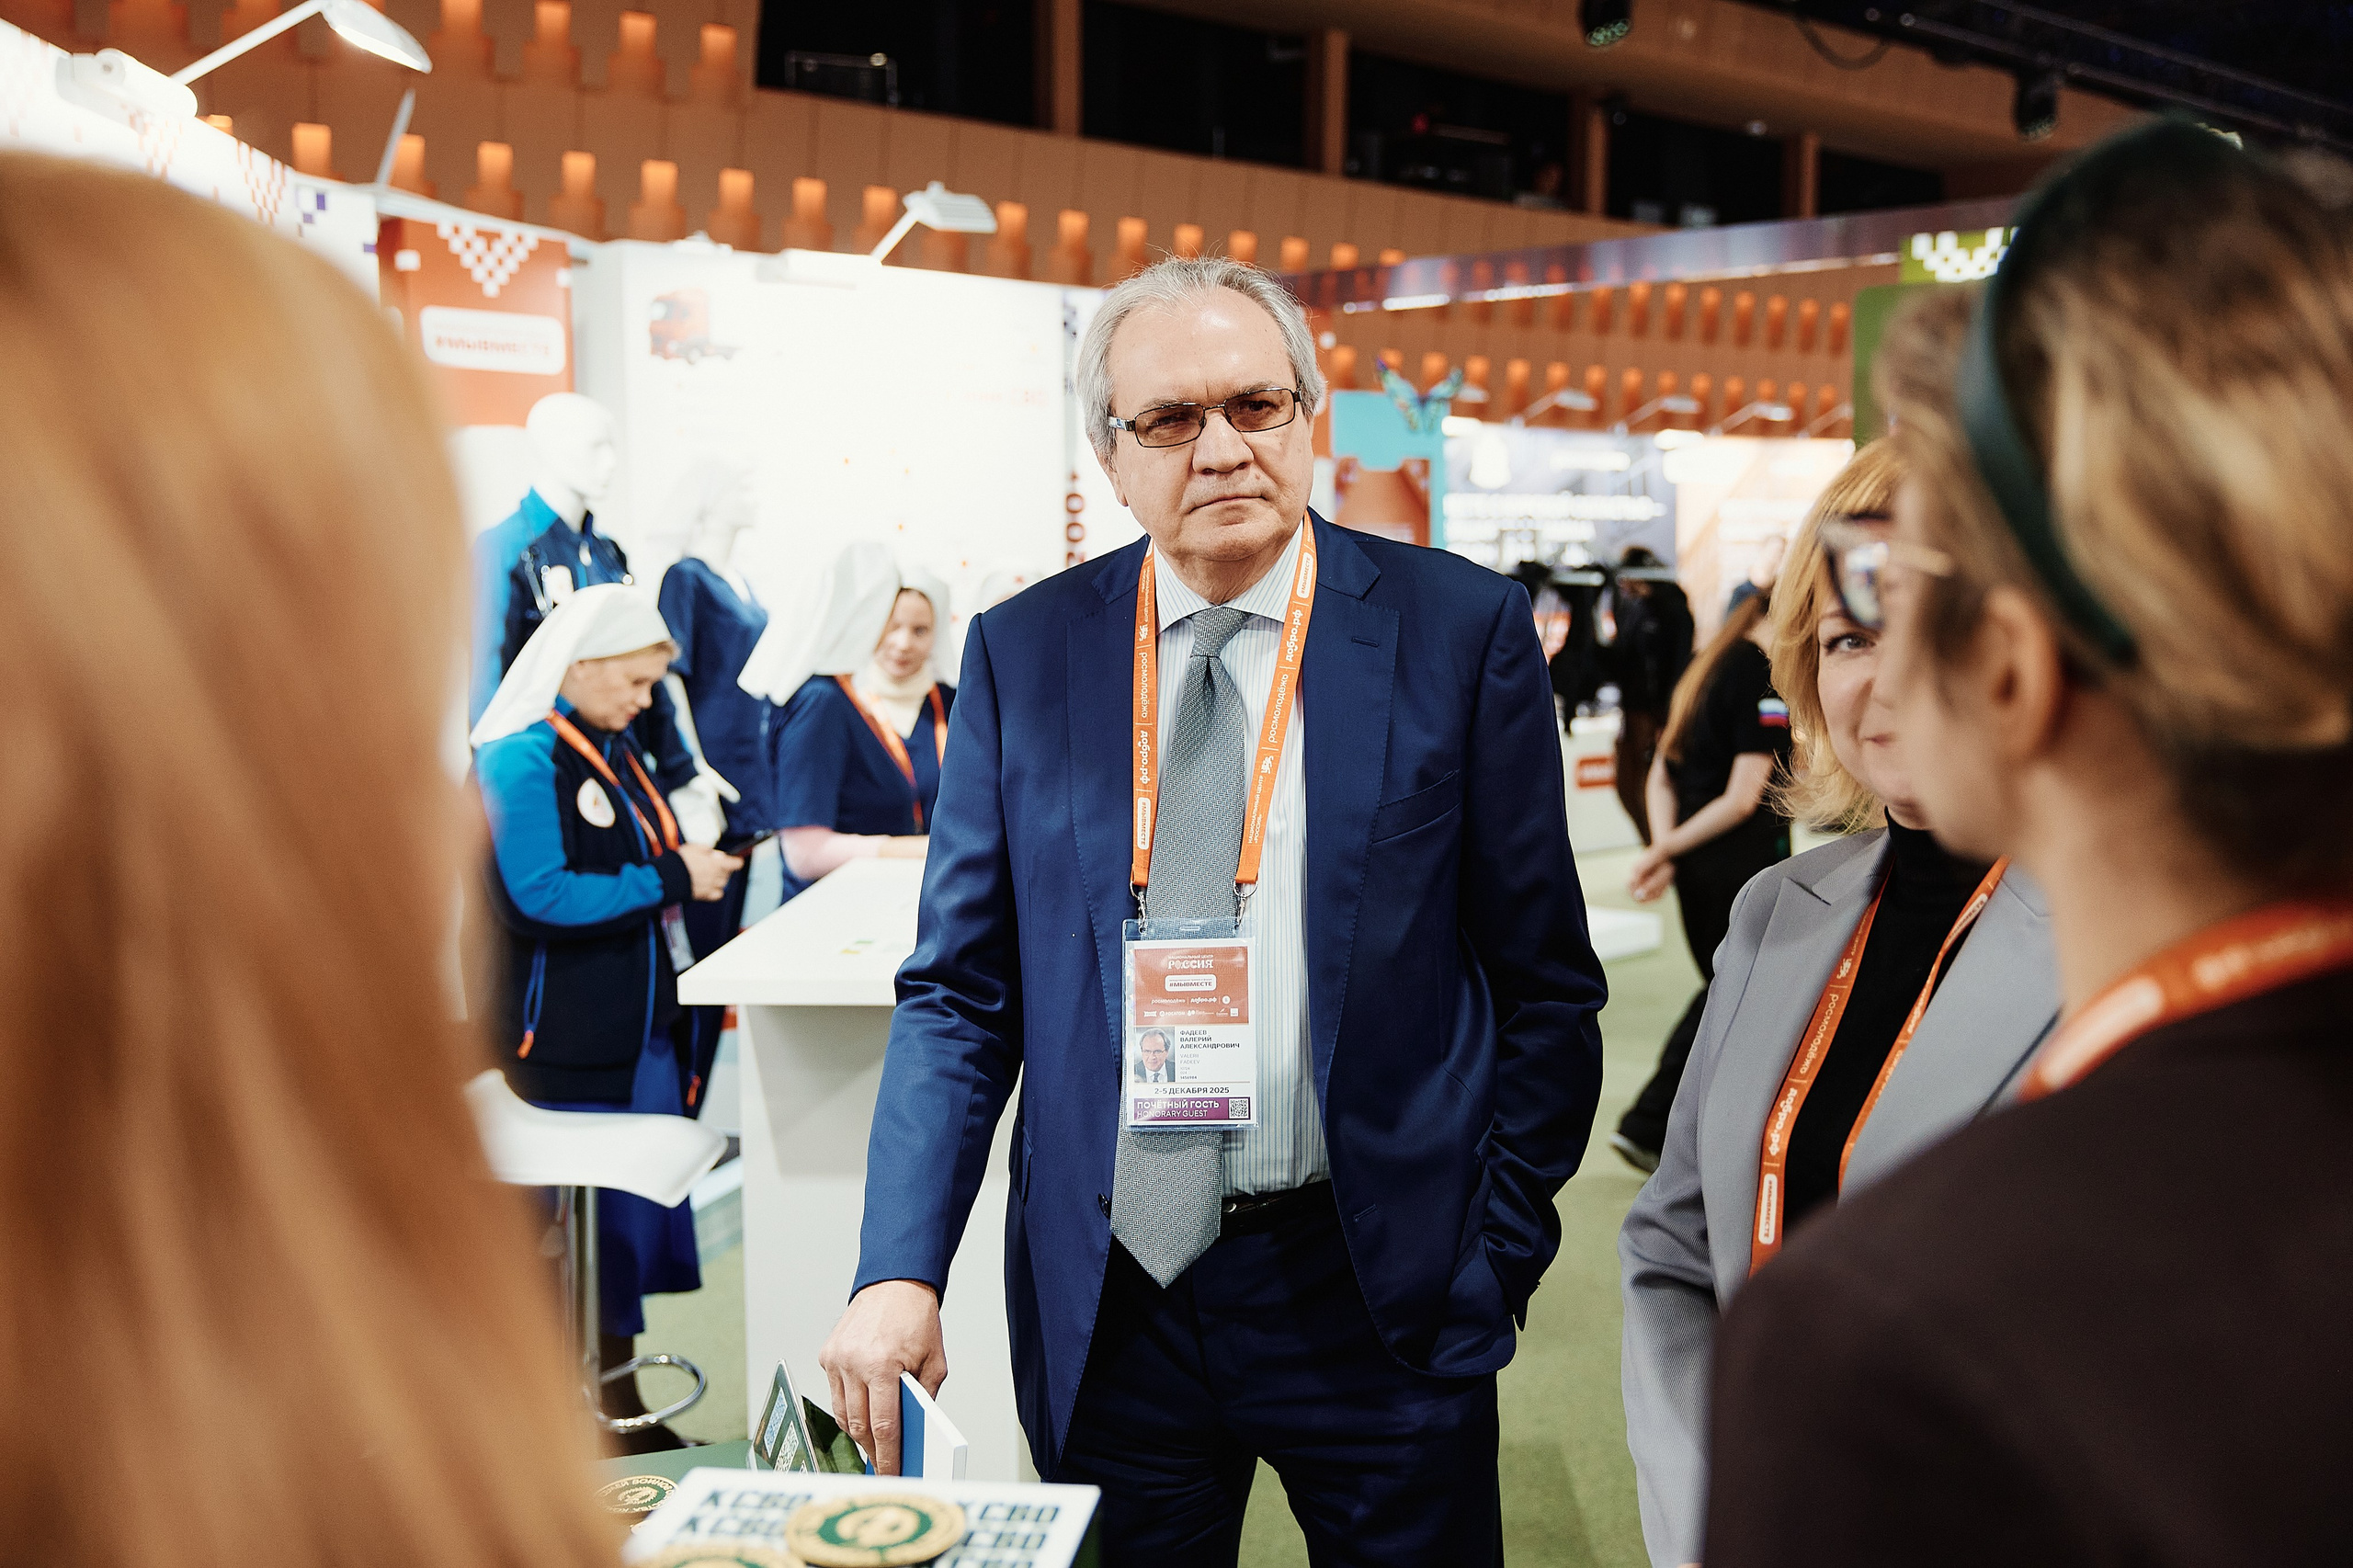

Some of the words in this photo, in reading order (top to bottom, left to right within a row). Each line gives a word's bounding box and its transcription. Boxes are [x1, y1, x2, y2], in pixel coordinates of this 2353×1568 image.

[1285, 608, 1303, 662] добро.рф
[1139, 652, 1150, 719] росмолодёжь
[1268, 673, 1289, 744] росмолодёжь
[1137, 730, 1151, 785] добро.рф
[1247, 793, 1260, 844] НАЦИОНАЛЬНЫЙ
[1254, 813, 1262, 845] «РОССИЯ»
[1168, 960, 1213, 970] РОССИЯ
[1799, 993, 1839, 1074] росмолодёжь
[1137, 1098, 1188, 1109] ПОЧЁТНЫЙ
[1189, 1100, 1220, 1108] ГОСТЬ
[1768, 1087, 1798, 1156] добро.рф
